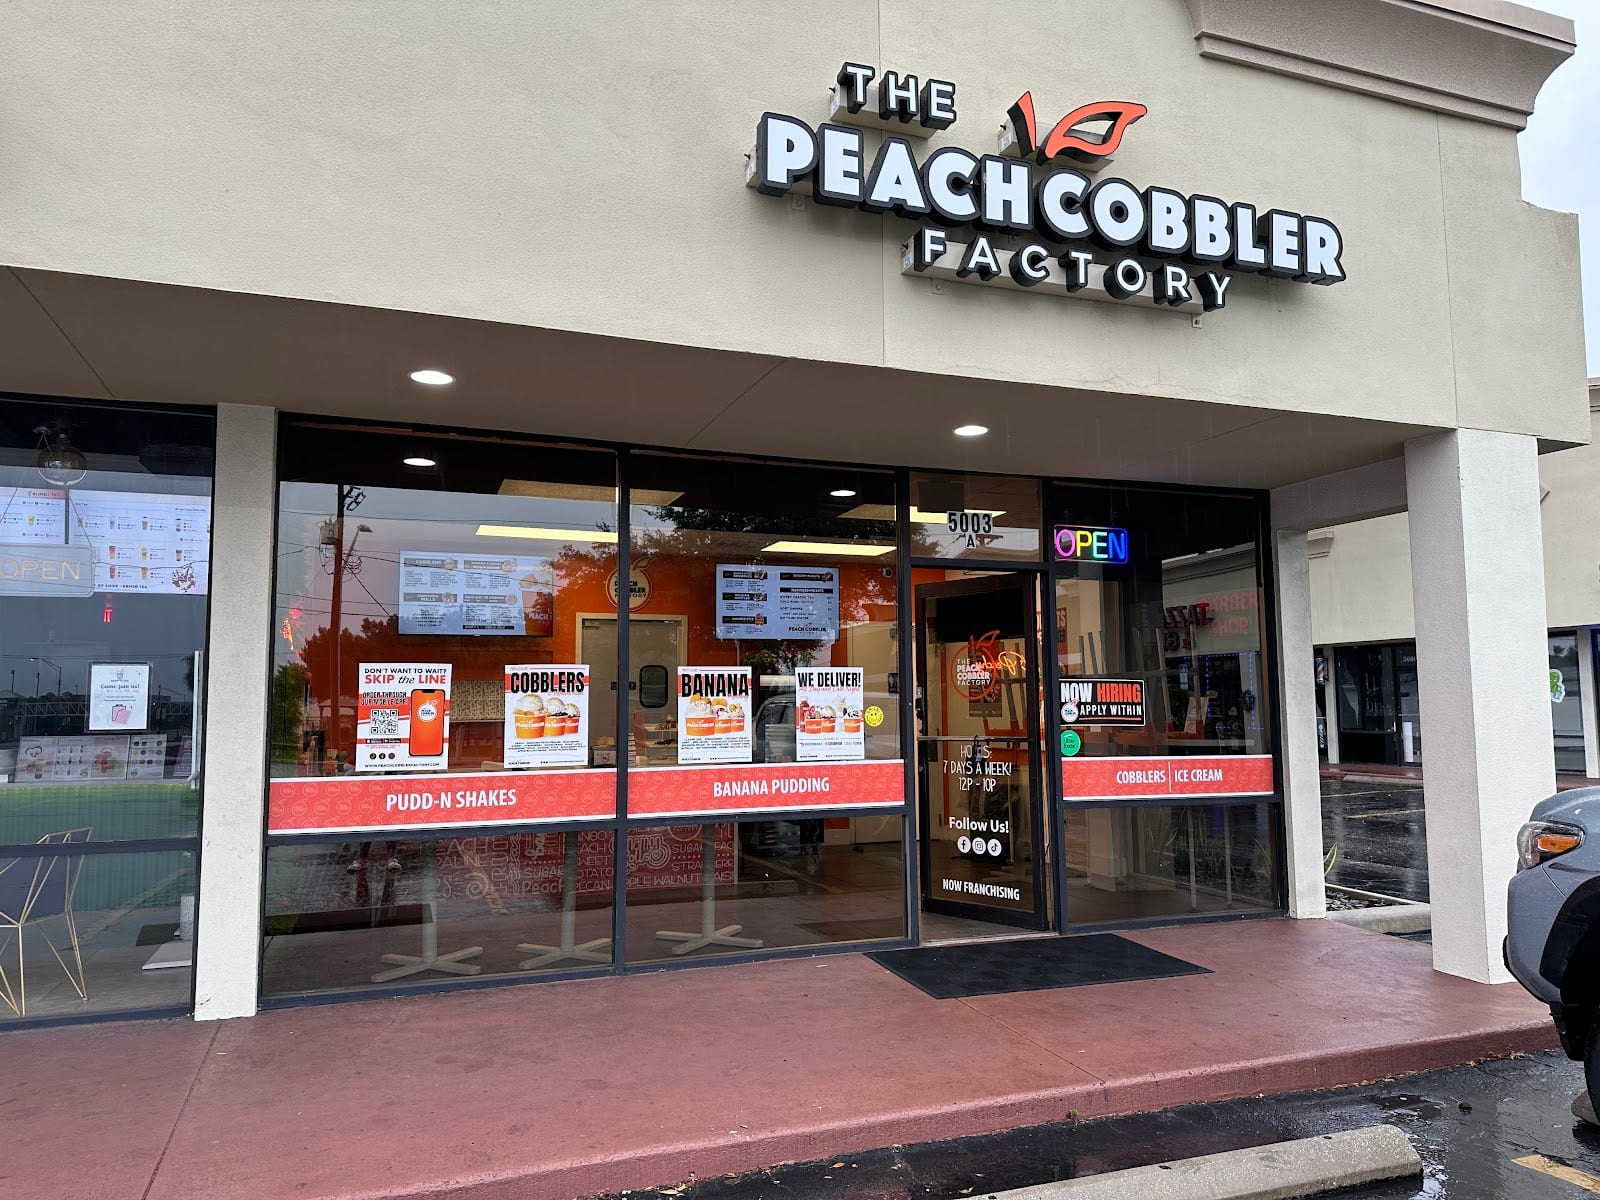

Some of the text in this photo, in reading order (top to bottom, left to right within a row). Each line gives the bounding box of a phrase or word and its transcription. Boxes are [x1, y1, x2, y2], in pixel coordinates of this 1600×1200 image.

[843, 64, 955, 124] THE
[764, 114, 1344, 279] PEACH COBBLER
[922, 228, 1230, 306] FACTORY
[948, 512, 992, 533] 5003
[966, 534, 976, 547] A
[1055, 529, 1125, 559] OPEN
[0, 559, 80, 580] OPEN
[1201, 591, 1258, 612] ARBER
[364, 674, 447, 684] SKIP the LINE
[511, 671, 585, 693] COBBLERS
[681, 673, 749, 697] BANANA
[797, 671, 861, 687] WE DELIVER!
[957, 671, 990, 680] COBBLER
[1060, 682, 1142, 703] NOW HIRING
[1080, 704, 1107, 716] APPLY
[1110, 704, 1142, 716] WITHIN
[960, 744, 993, 759] HOS:
[943, 760, 1012, 776] 7 DAYS A WEEK!
[1116, 769, 1167, 784] COBBLERS
[1174, 768, 1223, 783] ICE CREAM
[713, 777, 830, 798] BANANA PUDDING
[958, 777, 974, 791] 12P
[982, 778, 997, 793] 10P
[386, 788, 517, 812] PUDD-N SHAKES
[948, 816, 1010, 834] Follow Us!
[942, 878, 1020, 901] NOW FRANCHISING
